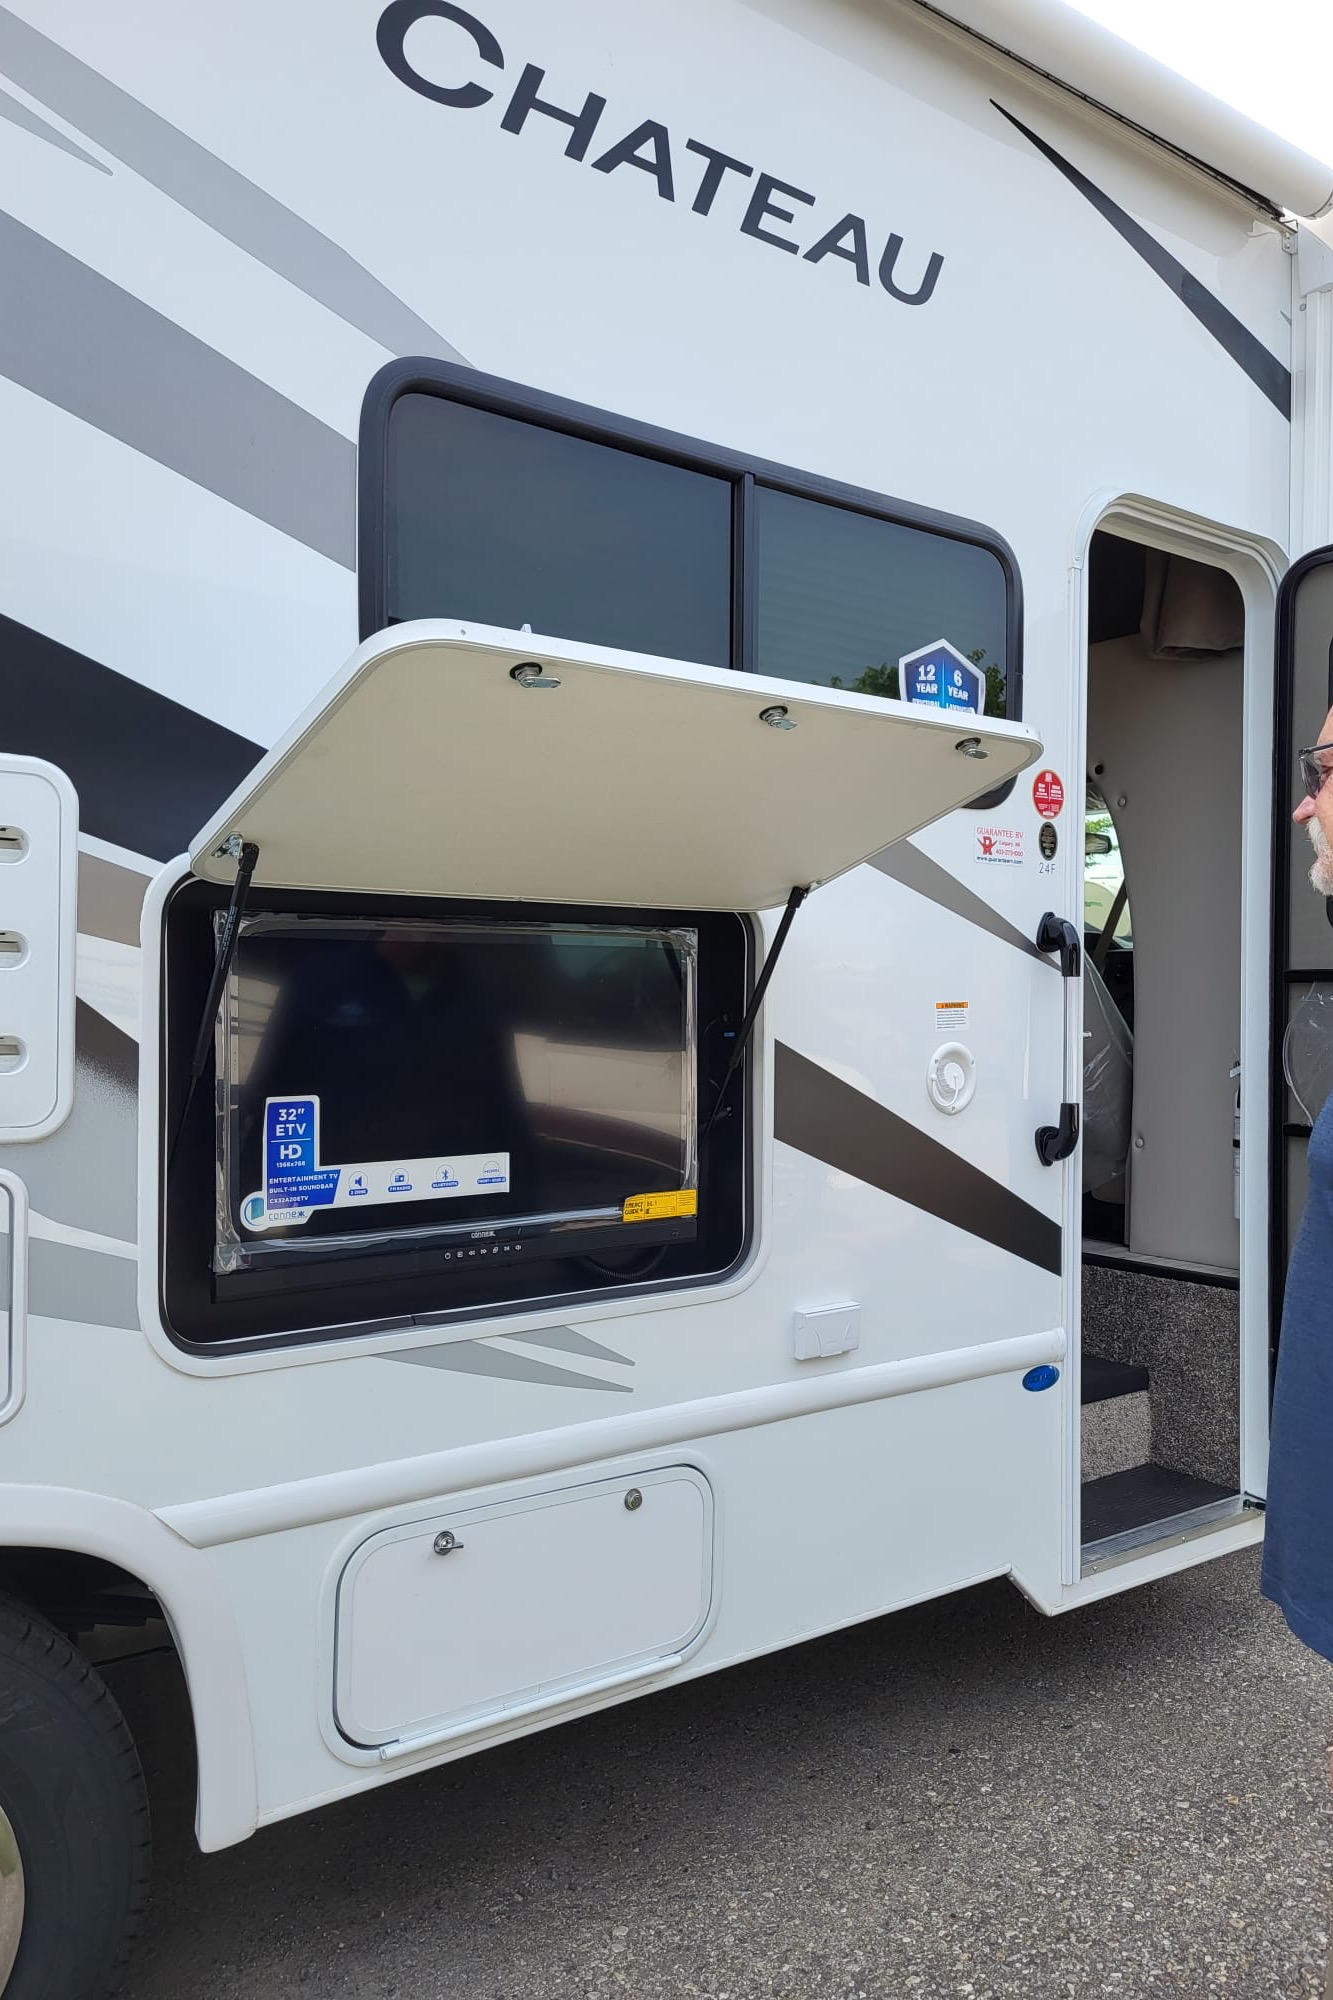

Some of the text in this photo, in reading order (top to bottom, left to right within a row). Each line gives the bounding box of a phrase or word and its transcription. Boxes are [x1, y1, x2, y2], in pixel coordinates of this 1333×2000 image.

[376, 0, 945, 306] CHATEAU
[918, 664, 936, 681] 12
[953, 669, 963, 687] 6
[915, 682, 939, 695] YEAR
[947, 684, 969, 701] YEAR
[976, 827, 1024, 839] GUARANTEE RV
[1038, 862, 1056, 875] 24F
[275, 1123, 307, 1137] ETV
[280, 1144, 302, 1160] HD
[269, 1174, 327, 1185] ENTERTAINMENT
[269, 1183, 334, 1194] BUILT-IN SOUNDBAR
